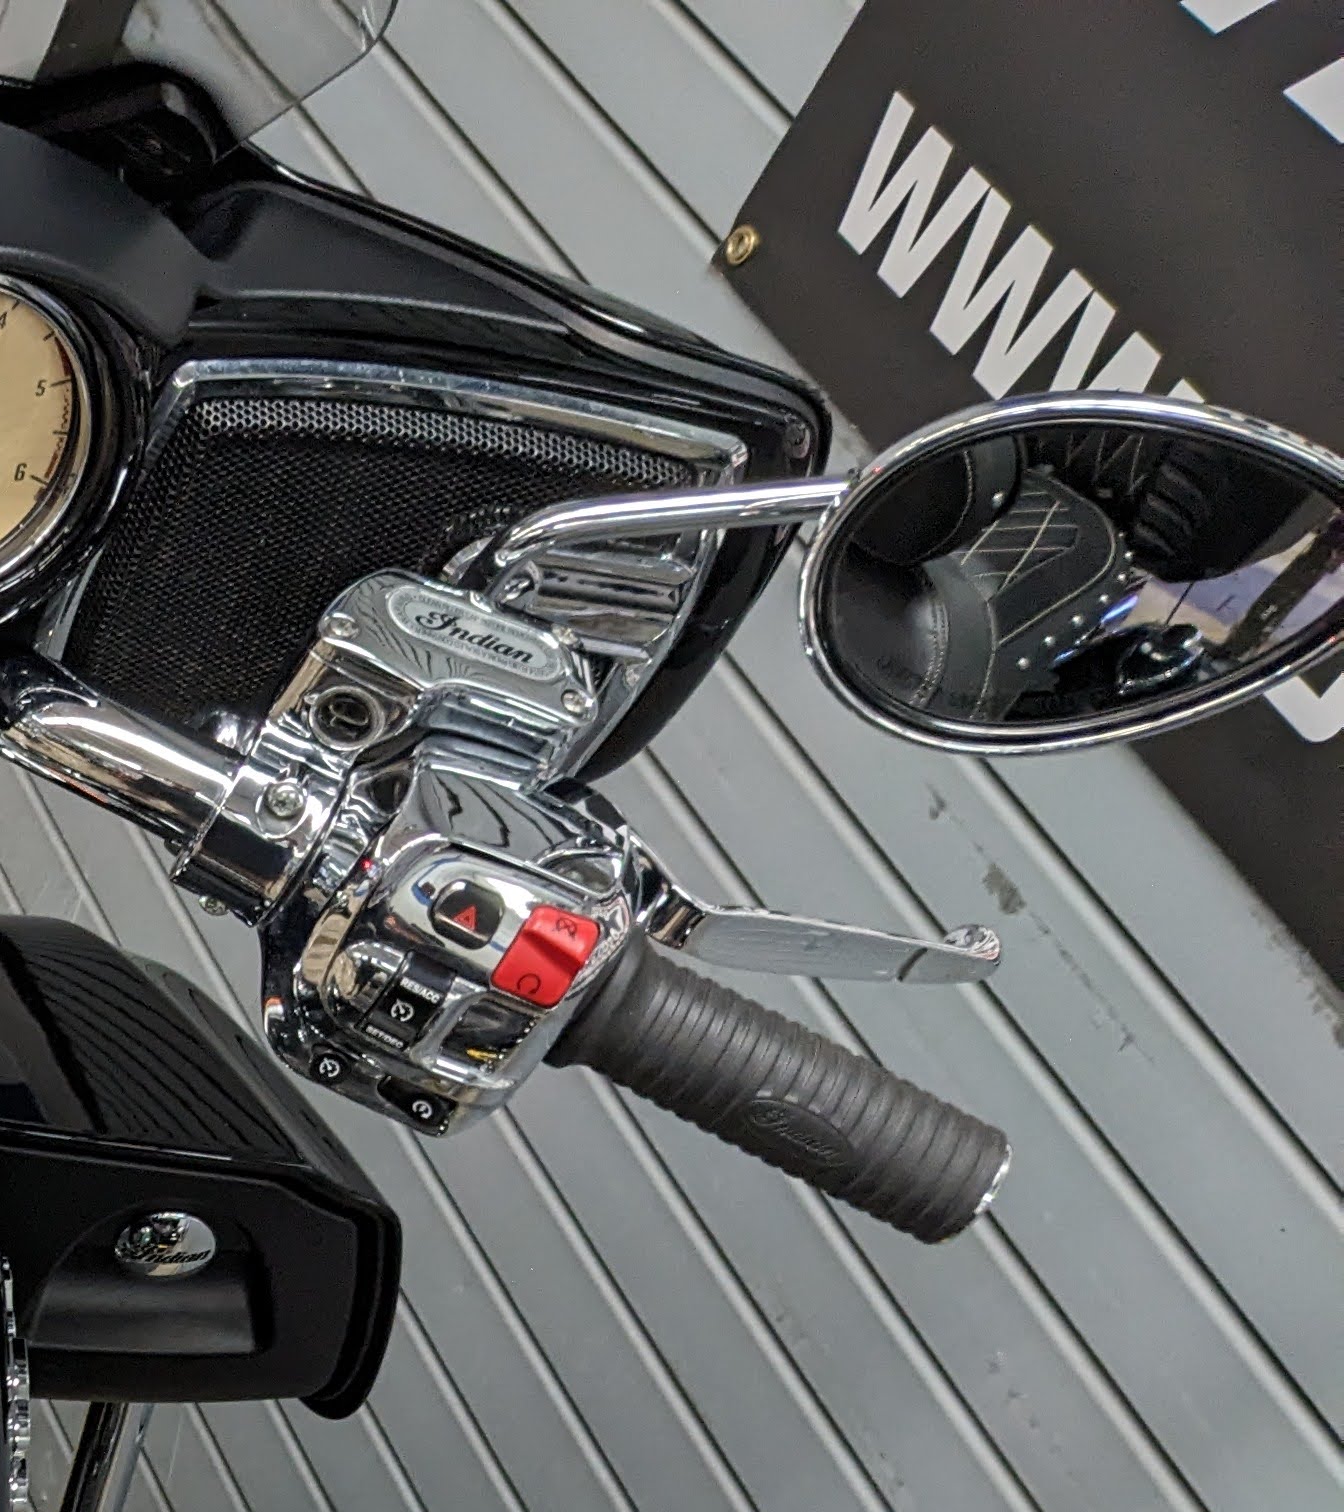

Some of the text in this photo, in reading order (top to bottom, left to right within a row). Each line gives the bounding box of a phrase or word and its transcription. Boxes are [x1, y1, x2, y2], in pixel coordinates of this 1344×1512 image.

[35, 380, 47, 397] 5
[14, 463, 27, 481] 6
[415, 610, 534, 665] Indian
[399, 976, 441, 1005] RES/ACC
